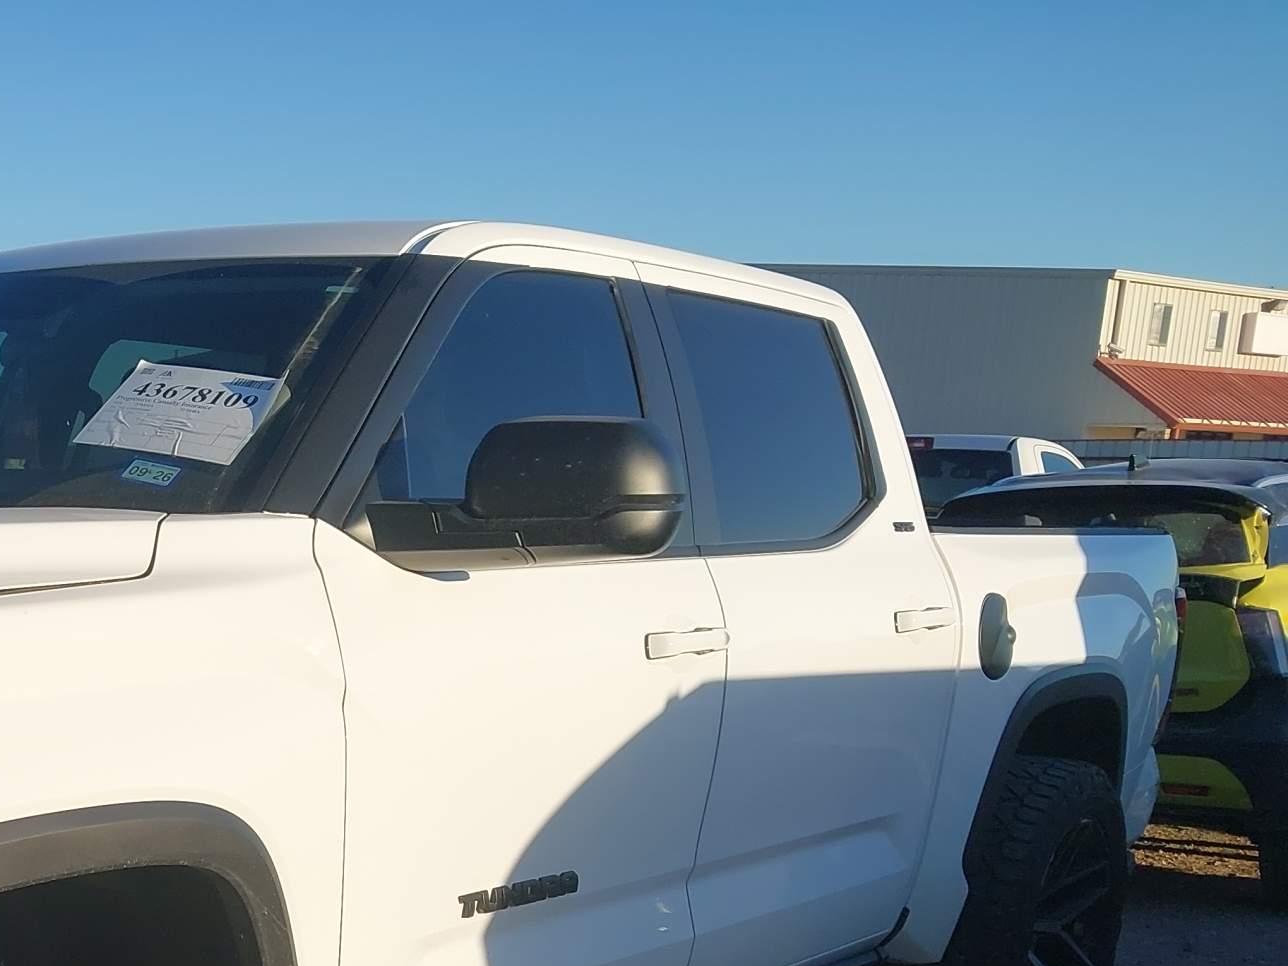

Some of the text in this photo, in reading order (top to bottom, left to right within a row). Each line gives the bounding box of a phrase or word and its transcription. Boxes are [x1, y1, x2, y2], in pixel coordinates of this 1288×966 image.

[133, 381, 259, 409] 43678109
[128, 466, 173, 482] 09 26
[458, 870, 579, 918] TUNDRA
